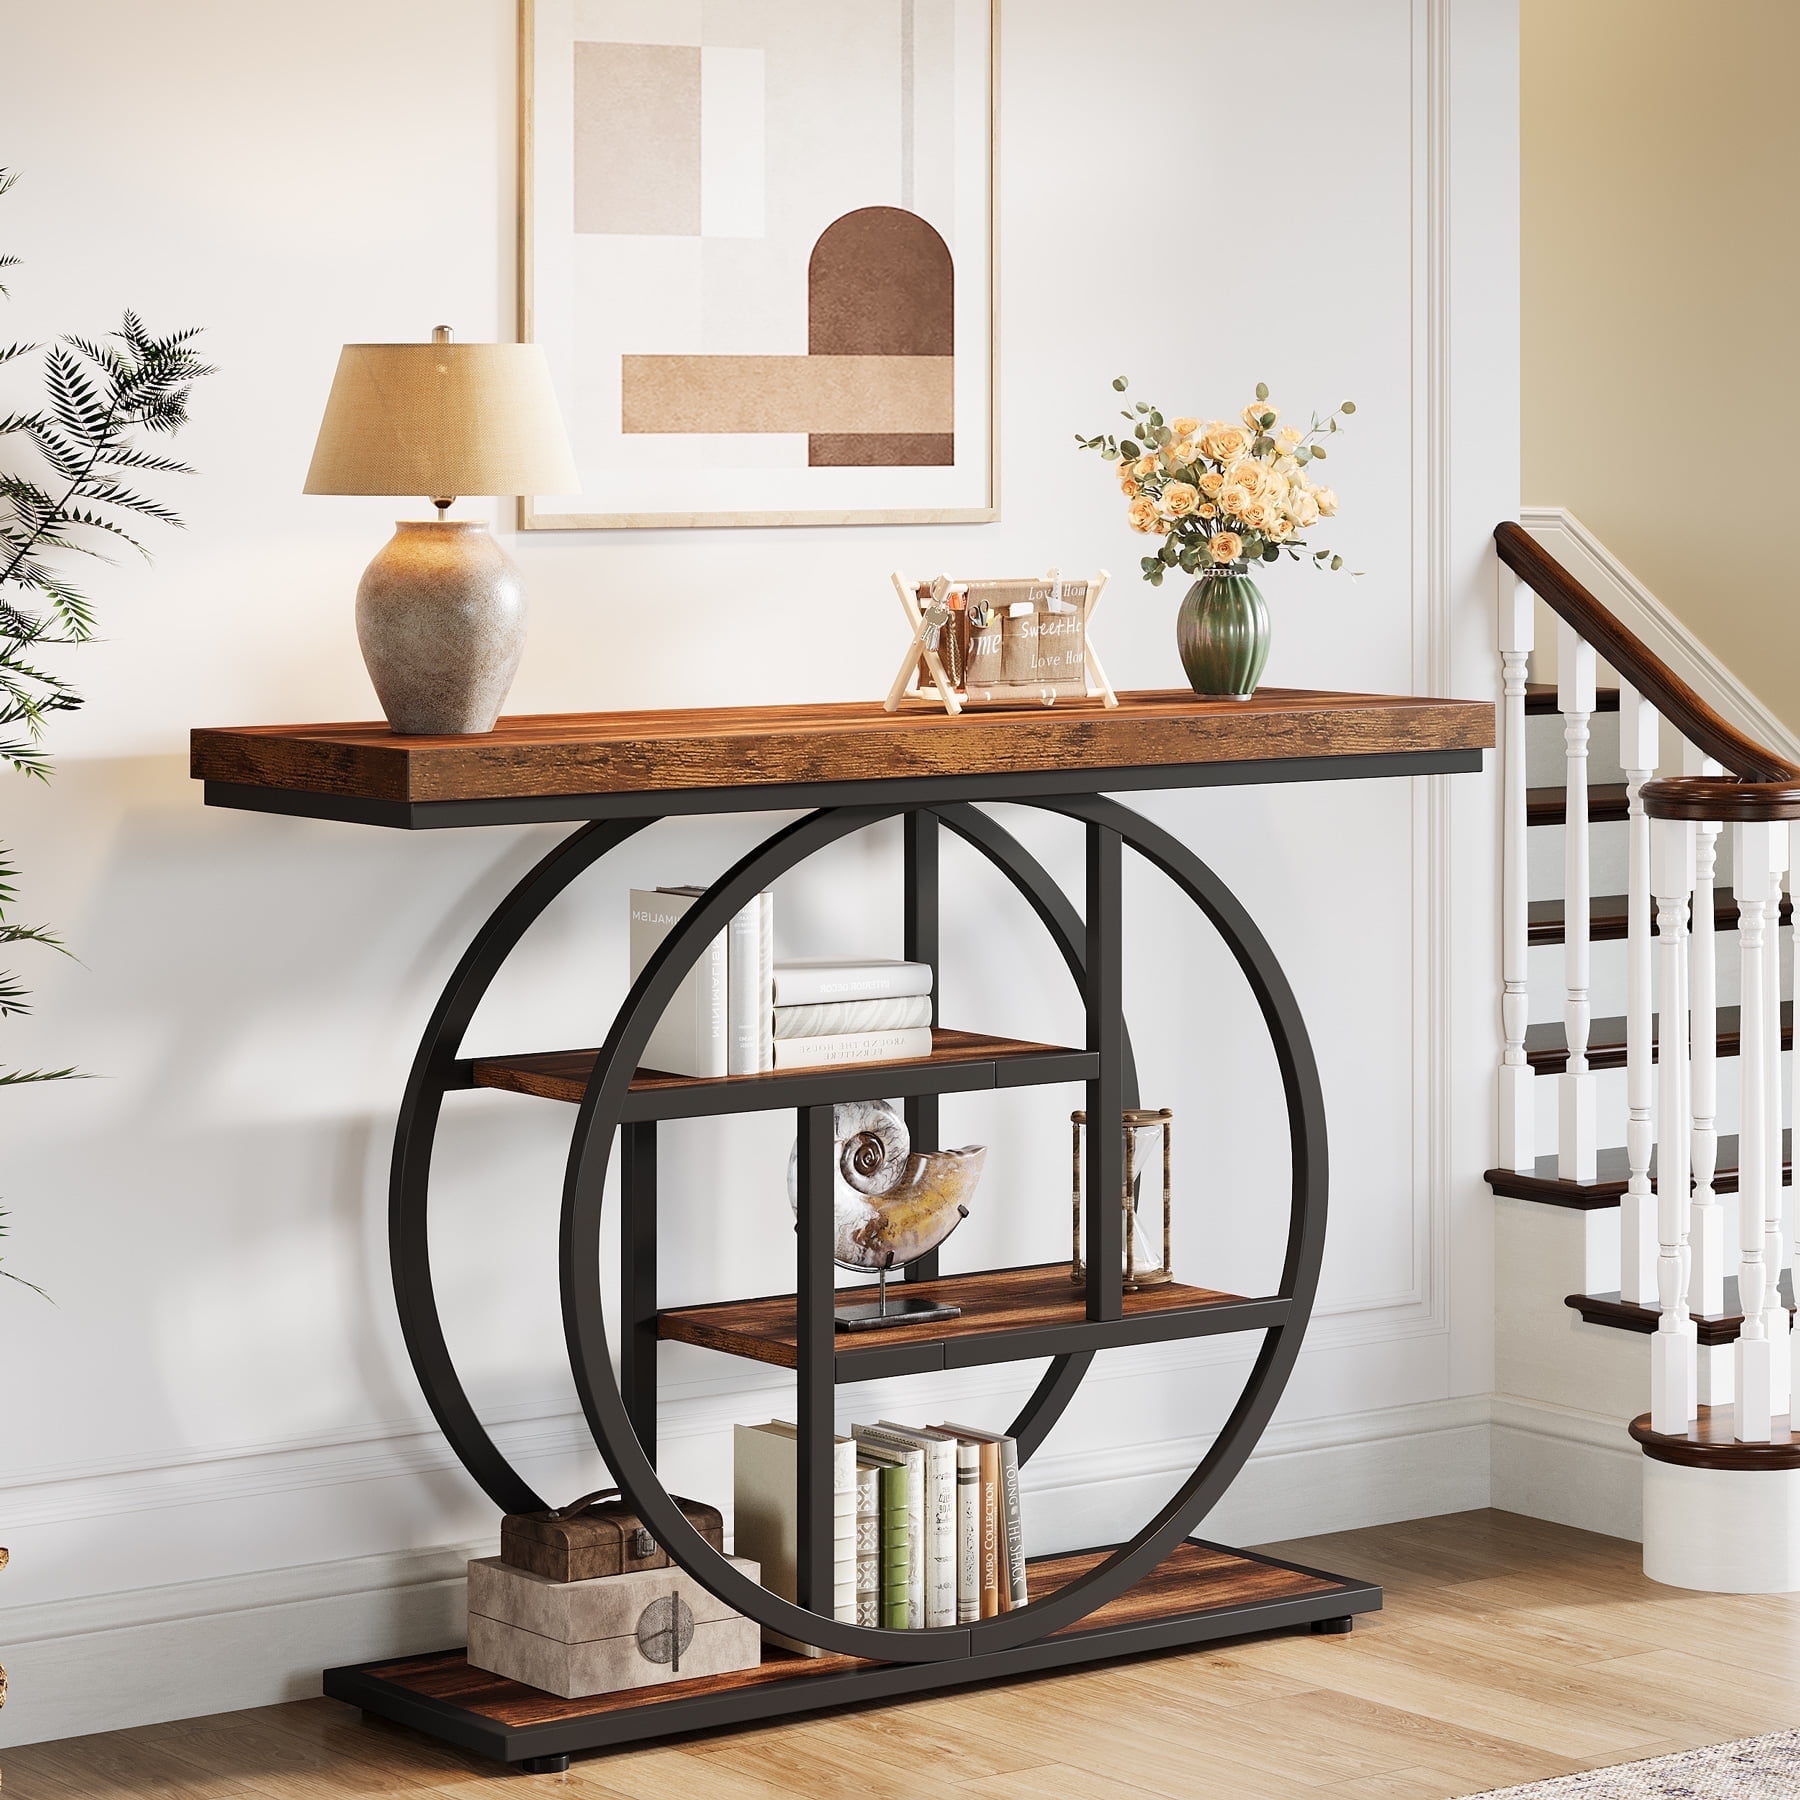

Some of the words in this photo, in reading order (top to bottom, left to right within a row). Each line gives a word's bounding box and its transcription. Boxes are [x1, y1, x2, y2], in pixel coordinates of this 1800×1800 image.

[1028, 586, 1051, 601] Lov
[1021, 618, 1064, 639] Sweet
[1031, 653, 1060, 669] Love
[1005, 1461, 1019, 1506] YOUNG
[984, 1482, 995, 1547] COLLECTION
[1008, 1517, 1021, 1542] THE
[984, 1553, 995, 1590] JUMBO
[1009, 1543, 1024, 1587] SHACK
